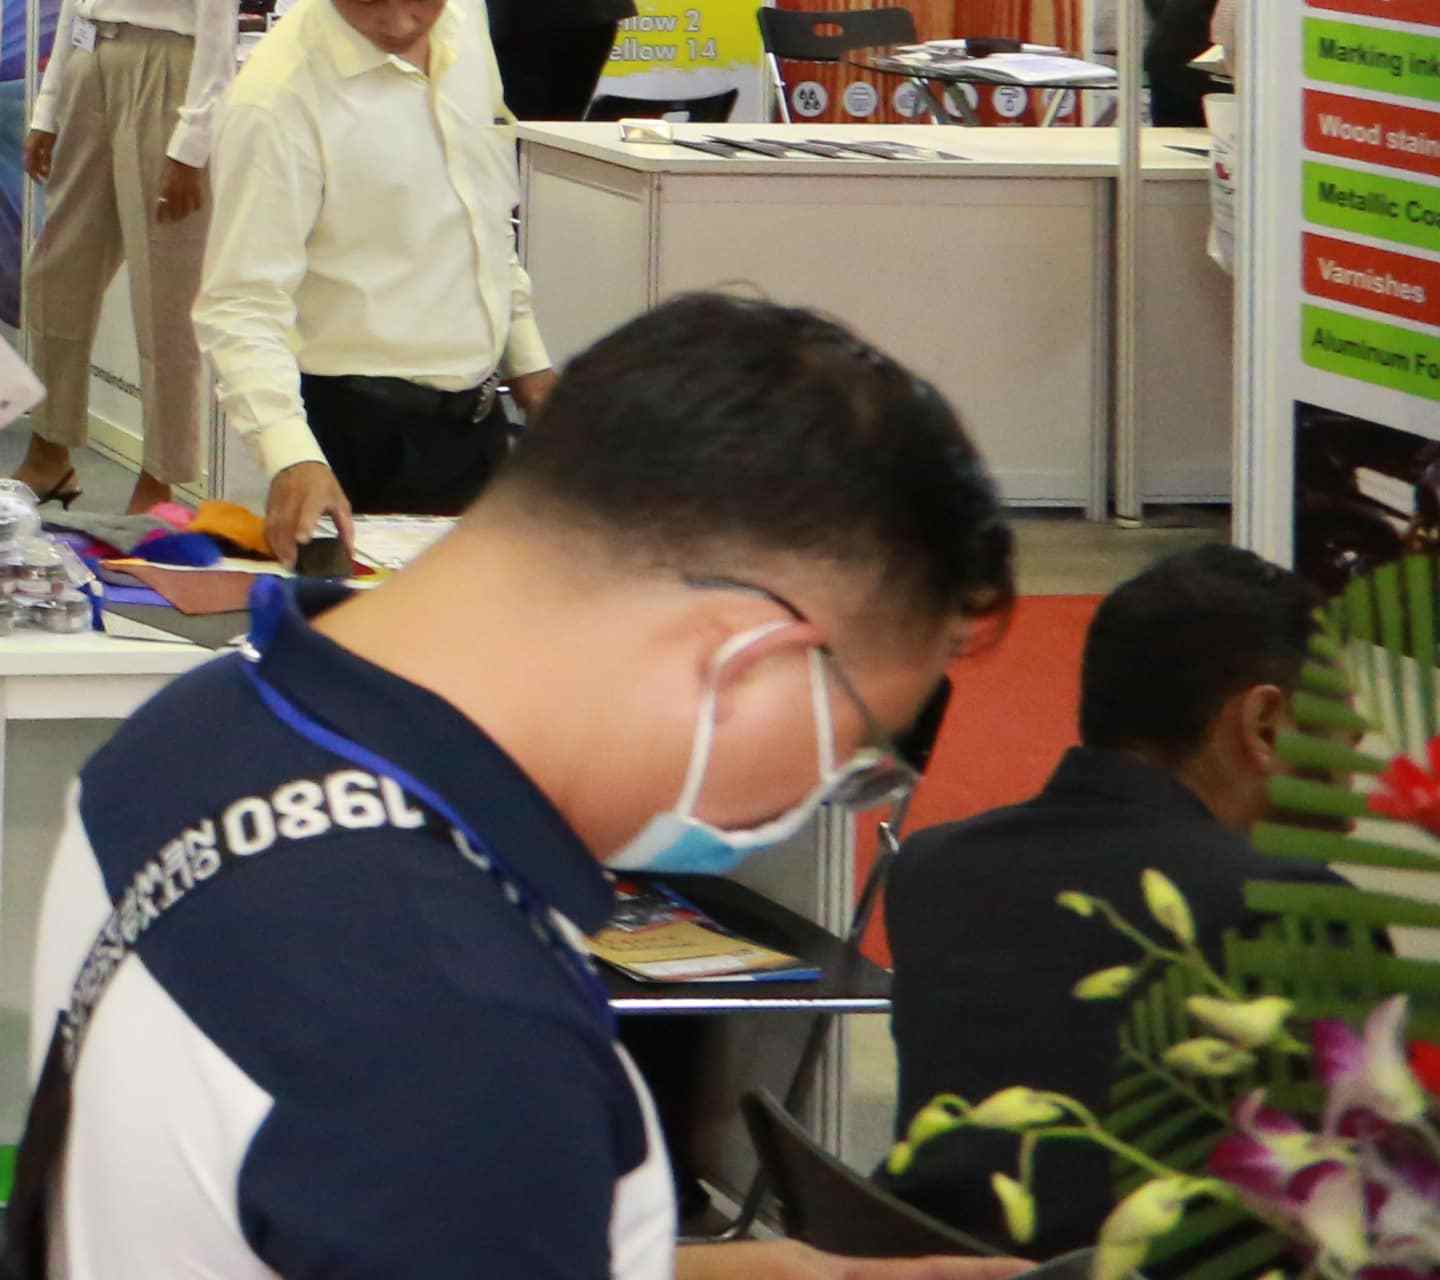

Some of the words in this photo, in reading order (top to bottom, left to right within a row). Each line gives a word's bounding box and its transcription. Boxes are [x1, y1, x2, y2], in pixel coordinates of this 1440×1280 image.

[1318, 36, 1403, 77] Marking
[1317, 112, 1380, 145] Wood
[1318, 181, 1399, 218] Metallic
[1317, 257, 1425, 303] Varnishes
